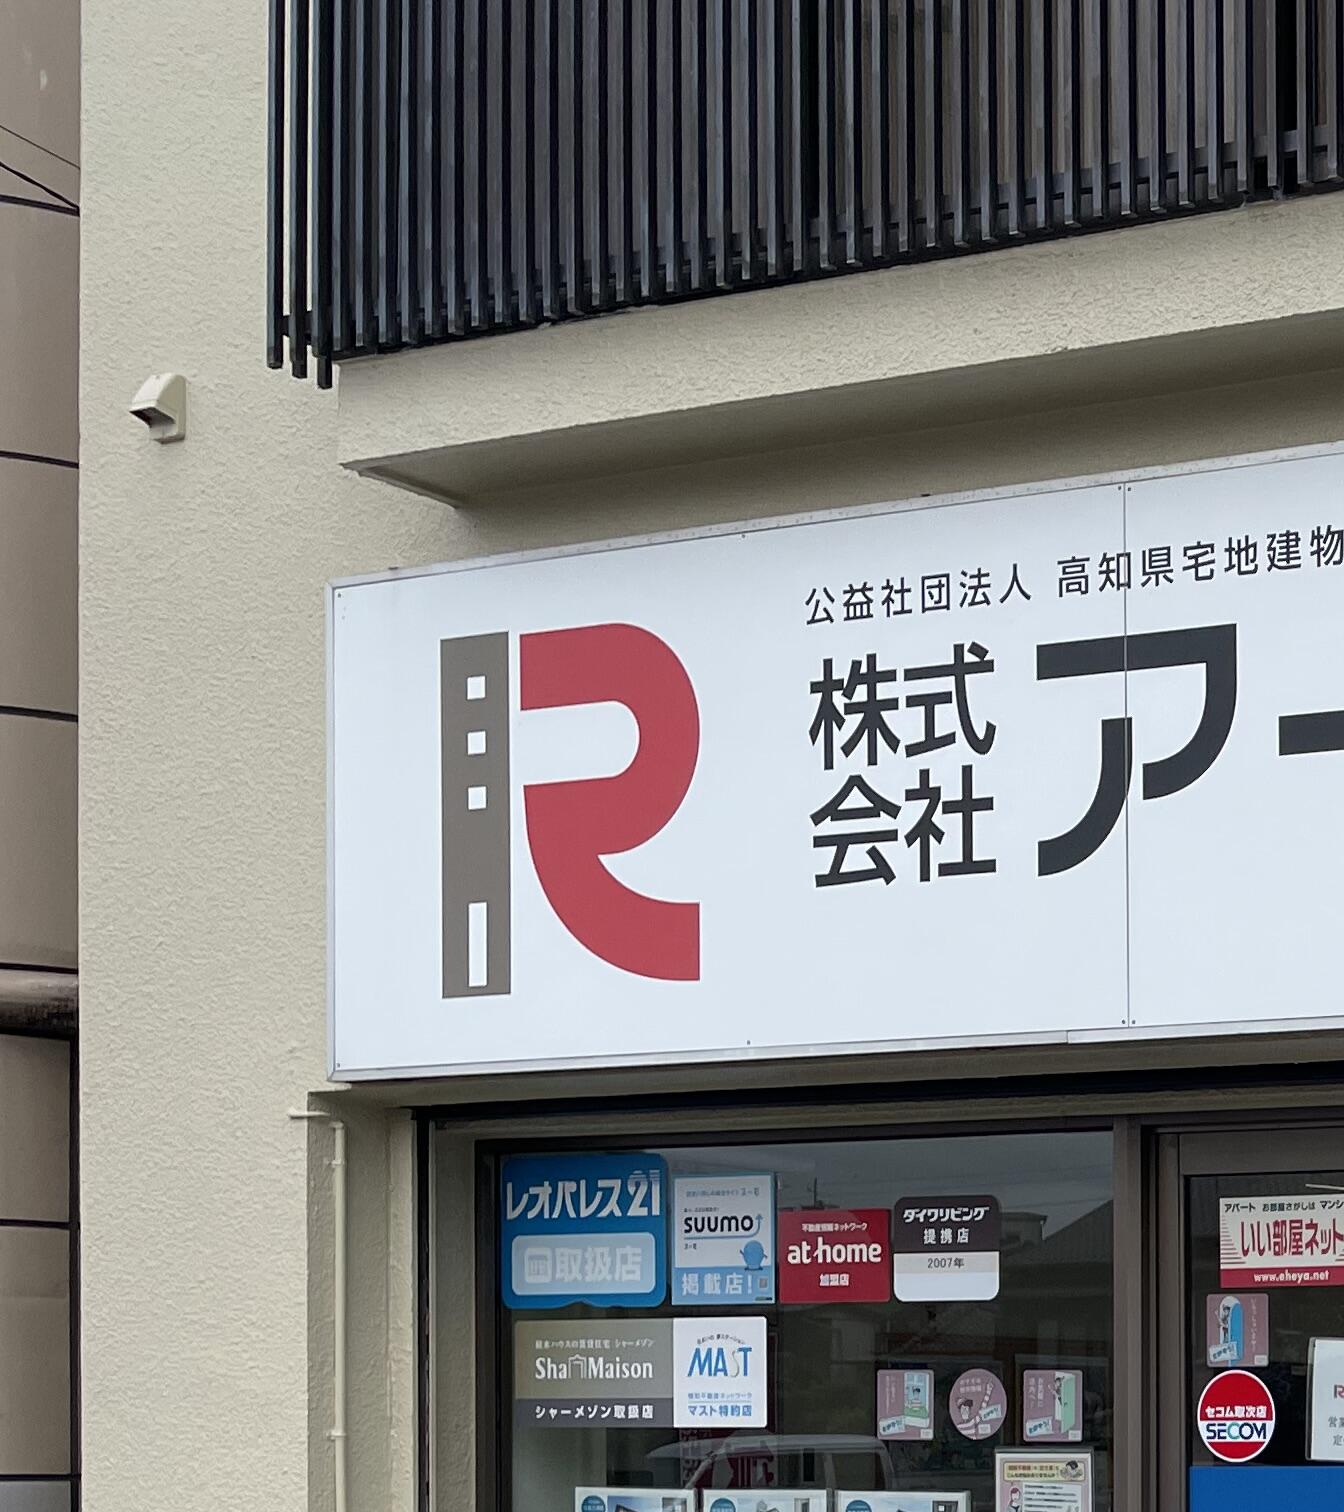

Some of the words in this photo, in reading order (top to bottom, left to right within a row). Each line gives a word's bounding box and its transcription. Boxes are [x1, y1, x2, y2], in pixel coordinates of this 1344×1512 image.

[805, 563, 1031, 625] 公益社団法人
[506, 1170, 660, 1220] レオパレス21
[903, 1207, 989, 1223] ダイワリビング
[1224, 1203, 1256, 1213] アパート
[1240, 1218, 1344, 1257] いい部屋ネット
[555, 1245, 642, 1282] 取扱店
[927, 1257, 964, 1269] 2007年
[687, 1347, 752, 1378] MAST
[535, 1404, 653, 1419] シャーメゾン取扱店
[688, 1405, 752, 1417] マスト特約店
[1206, 1422, 1267, 1440] SECOM
